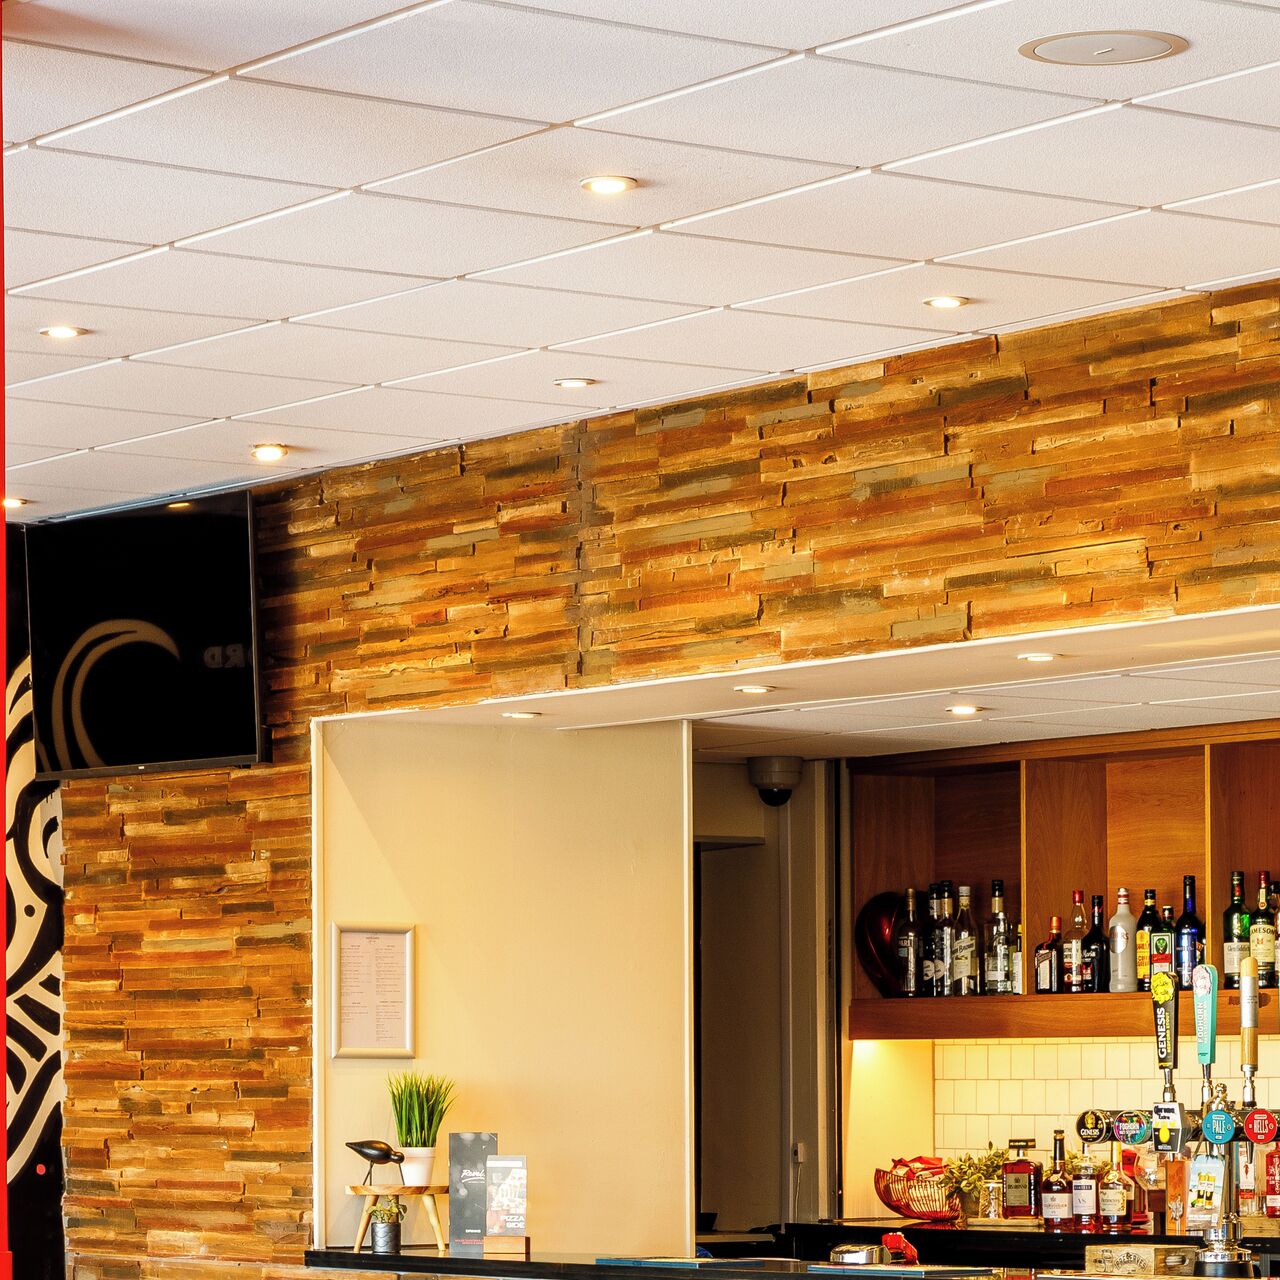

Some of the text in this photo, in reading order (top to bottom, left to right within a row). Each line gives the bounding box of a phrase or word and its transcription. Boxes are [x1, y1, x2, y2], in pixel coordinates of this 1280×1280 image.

[1156, 1007, 1167, 1058] GENESIS
[1080, 1128, 1100, 1136] GENESIS
[1212, 1120, 1226, 1133] PALE
[1253, 1120, 1269, 1133] HELLS
[1114, 1252, 1148, 1271] PRESERVES
